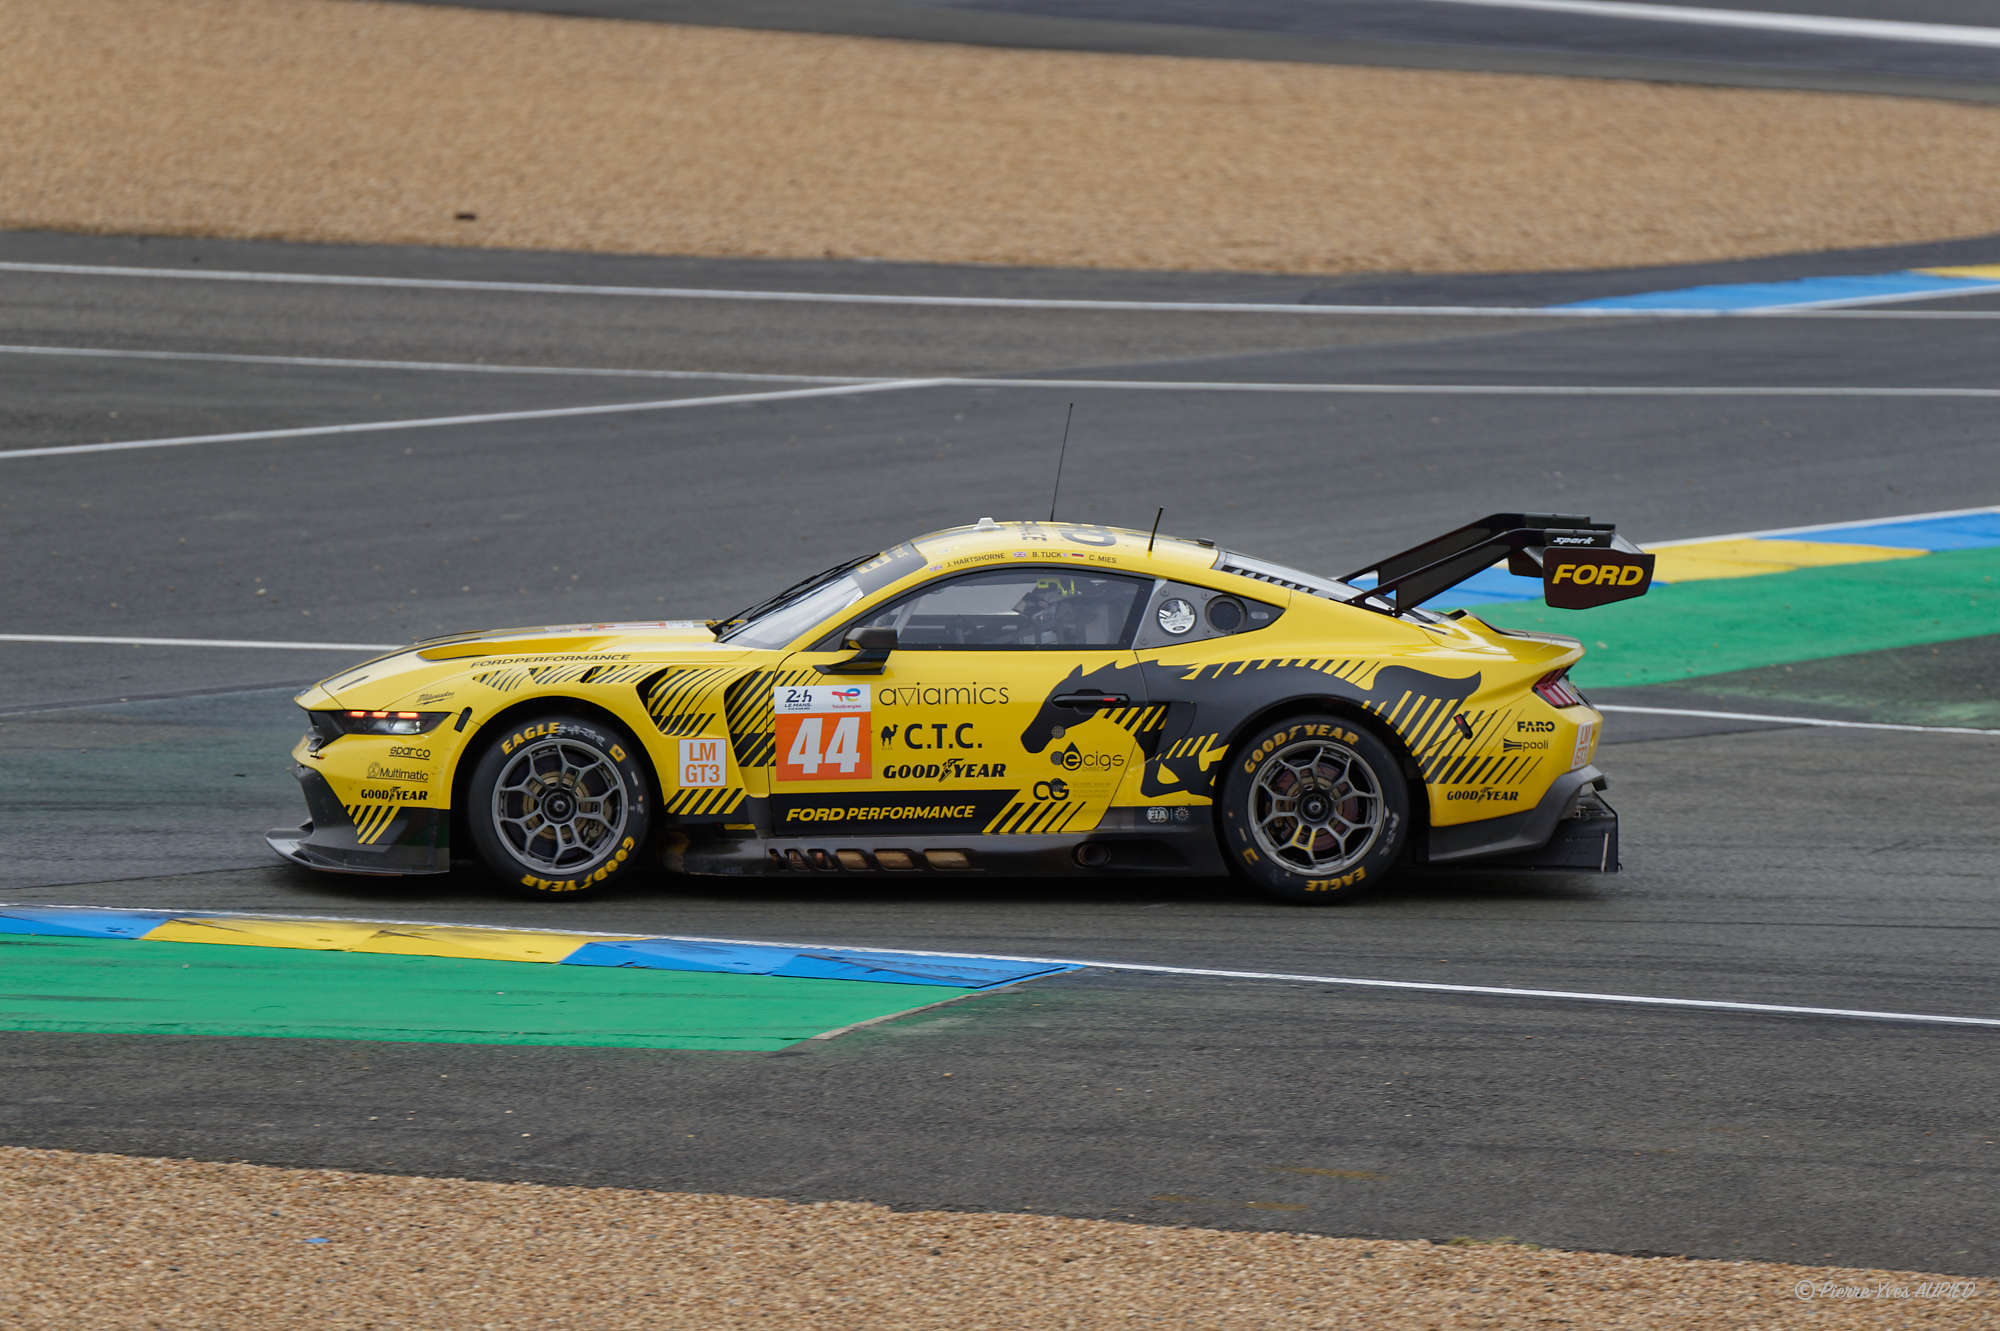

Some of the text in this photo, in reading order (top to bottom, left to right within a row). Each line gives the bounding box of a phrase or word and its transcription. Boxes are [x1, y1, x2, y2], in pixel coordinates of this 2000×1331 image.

[1553, 536, 1595, 545] spark
[954, 552, 1006, 566] HARTSHORNE
[1098, 555, 1117, 564] MIES
[1552, 563, 1645, 586] FORD
[879, 681, 1010, 706] aviamics
[1516, 721, 1555, 732] FARO
[501, 722, 561, 756] EAGLE
[904, 722, 983, 750] C.T.C.
[389, 745, 431, 758] sparco
[688, 742, 717, 763] LM
[786, 716, 861, 775] 44
[1522, 740, 1549, 752] paoli
[379, 767, 429, 782] Multimatic
[685, 763, 721, 784] GT3
[1147, 809, 1168, 821] FIA
[1304, 865, 1368, 893] EAGLE
